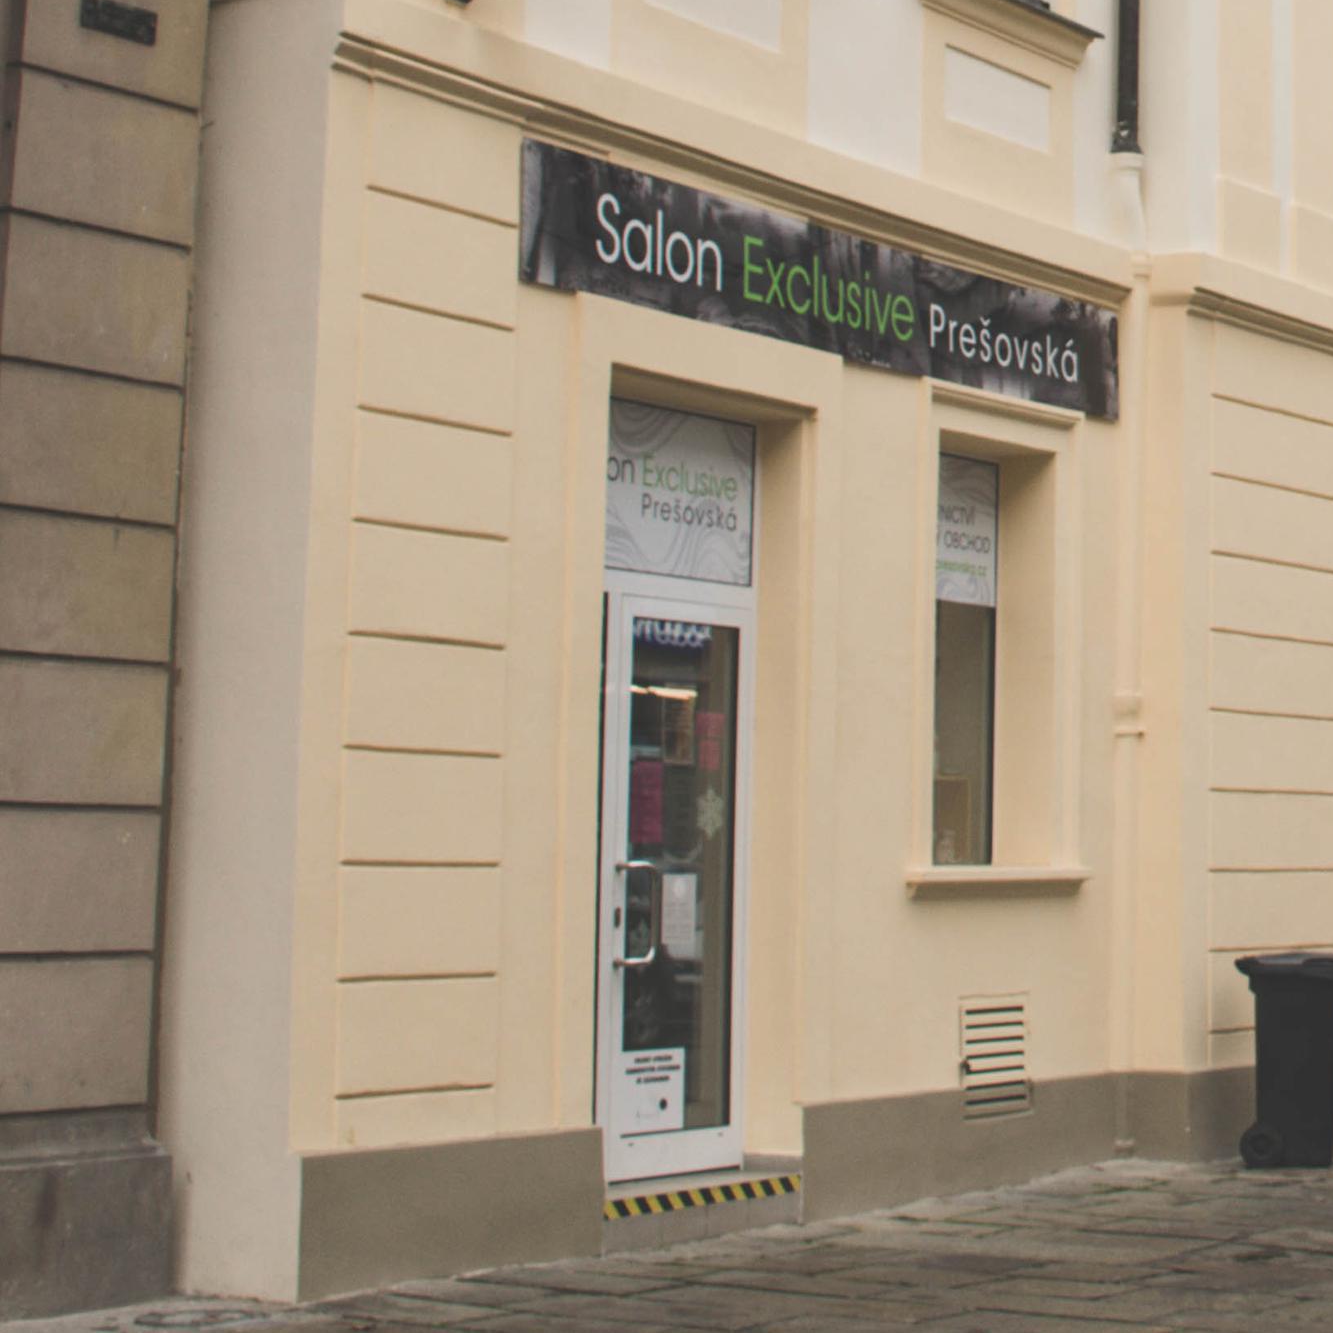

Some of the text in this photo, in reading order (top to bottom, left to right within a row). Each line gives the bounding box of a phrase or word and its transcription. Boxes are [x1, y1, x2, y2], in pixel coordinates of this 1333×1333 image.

[596, 193, 1080, 384] Salon Exclusive Prešovská
[641, 453, 738, 502] Exclusive
[641, 492, 738, 532] Prešovská
